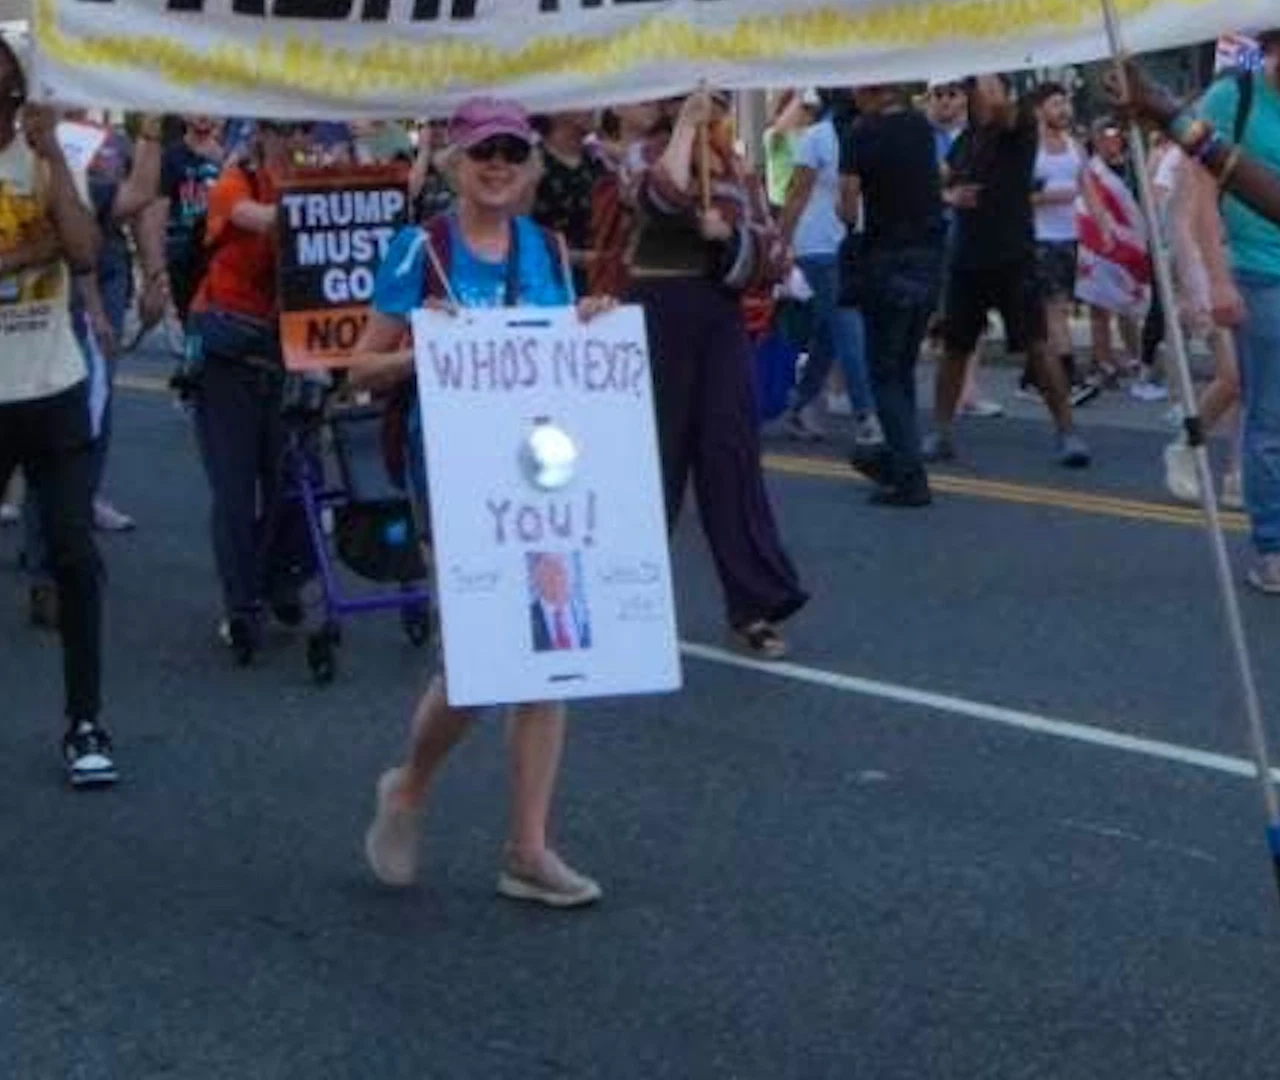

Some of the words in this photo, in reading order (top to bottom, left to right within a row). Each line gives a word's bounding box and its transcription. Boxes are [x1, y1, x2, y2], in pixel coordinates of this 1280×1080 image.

[282, 190, 406, 229] TRUMP
[296, 227, 396, 266] MUST
[322, 266, 375, 303] GO
[306, 314, 369, 351] NO
[551, 339, 644, 399] NEXT?
